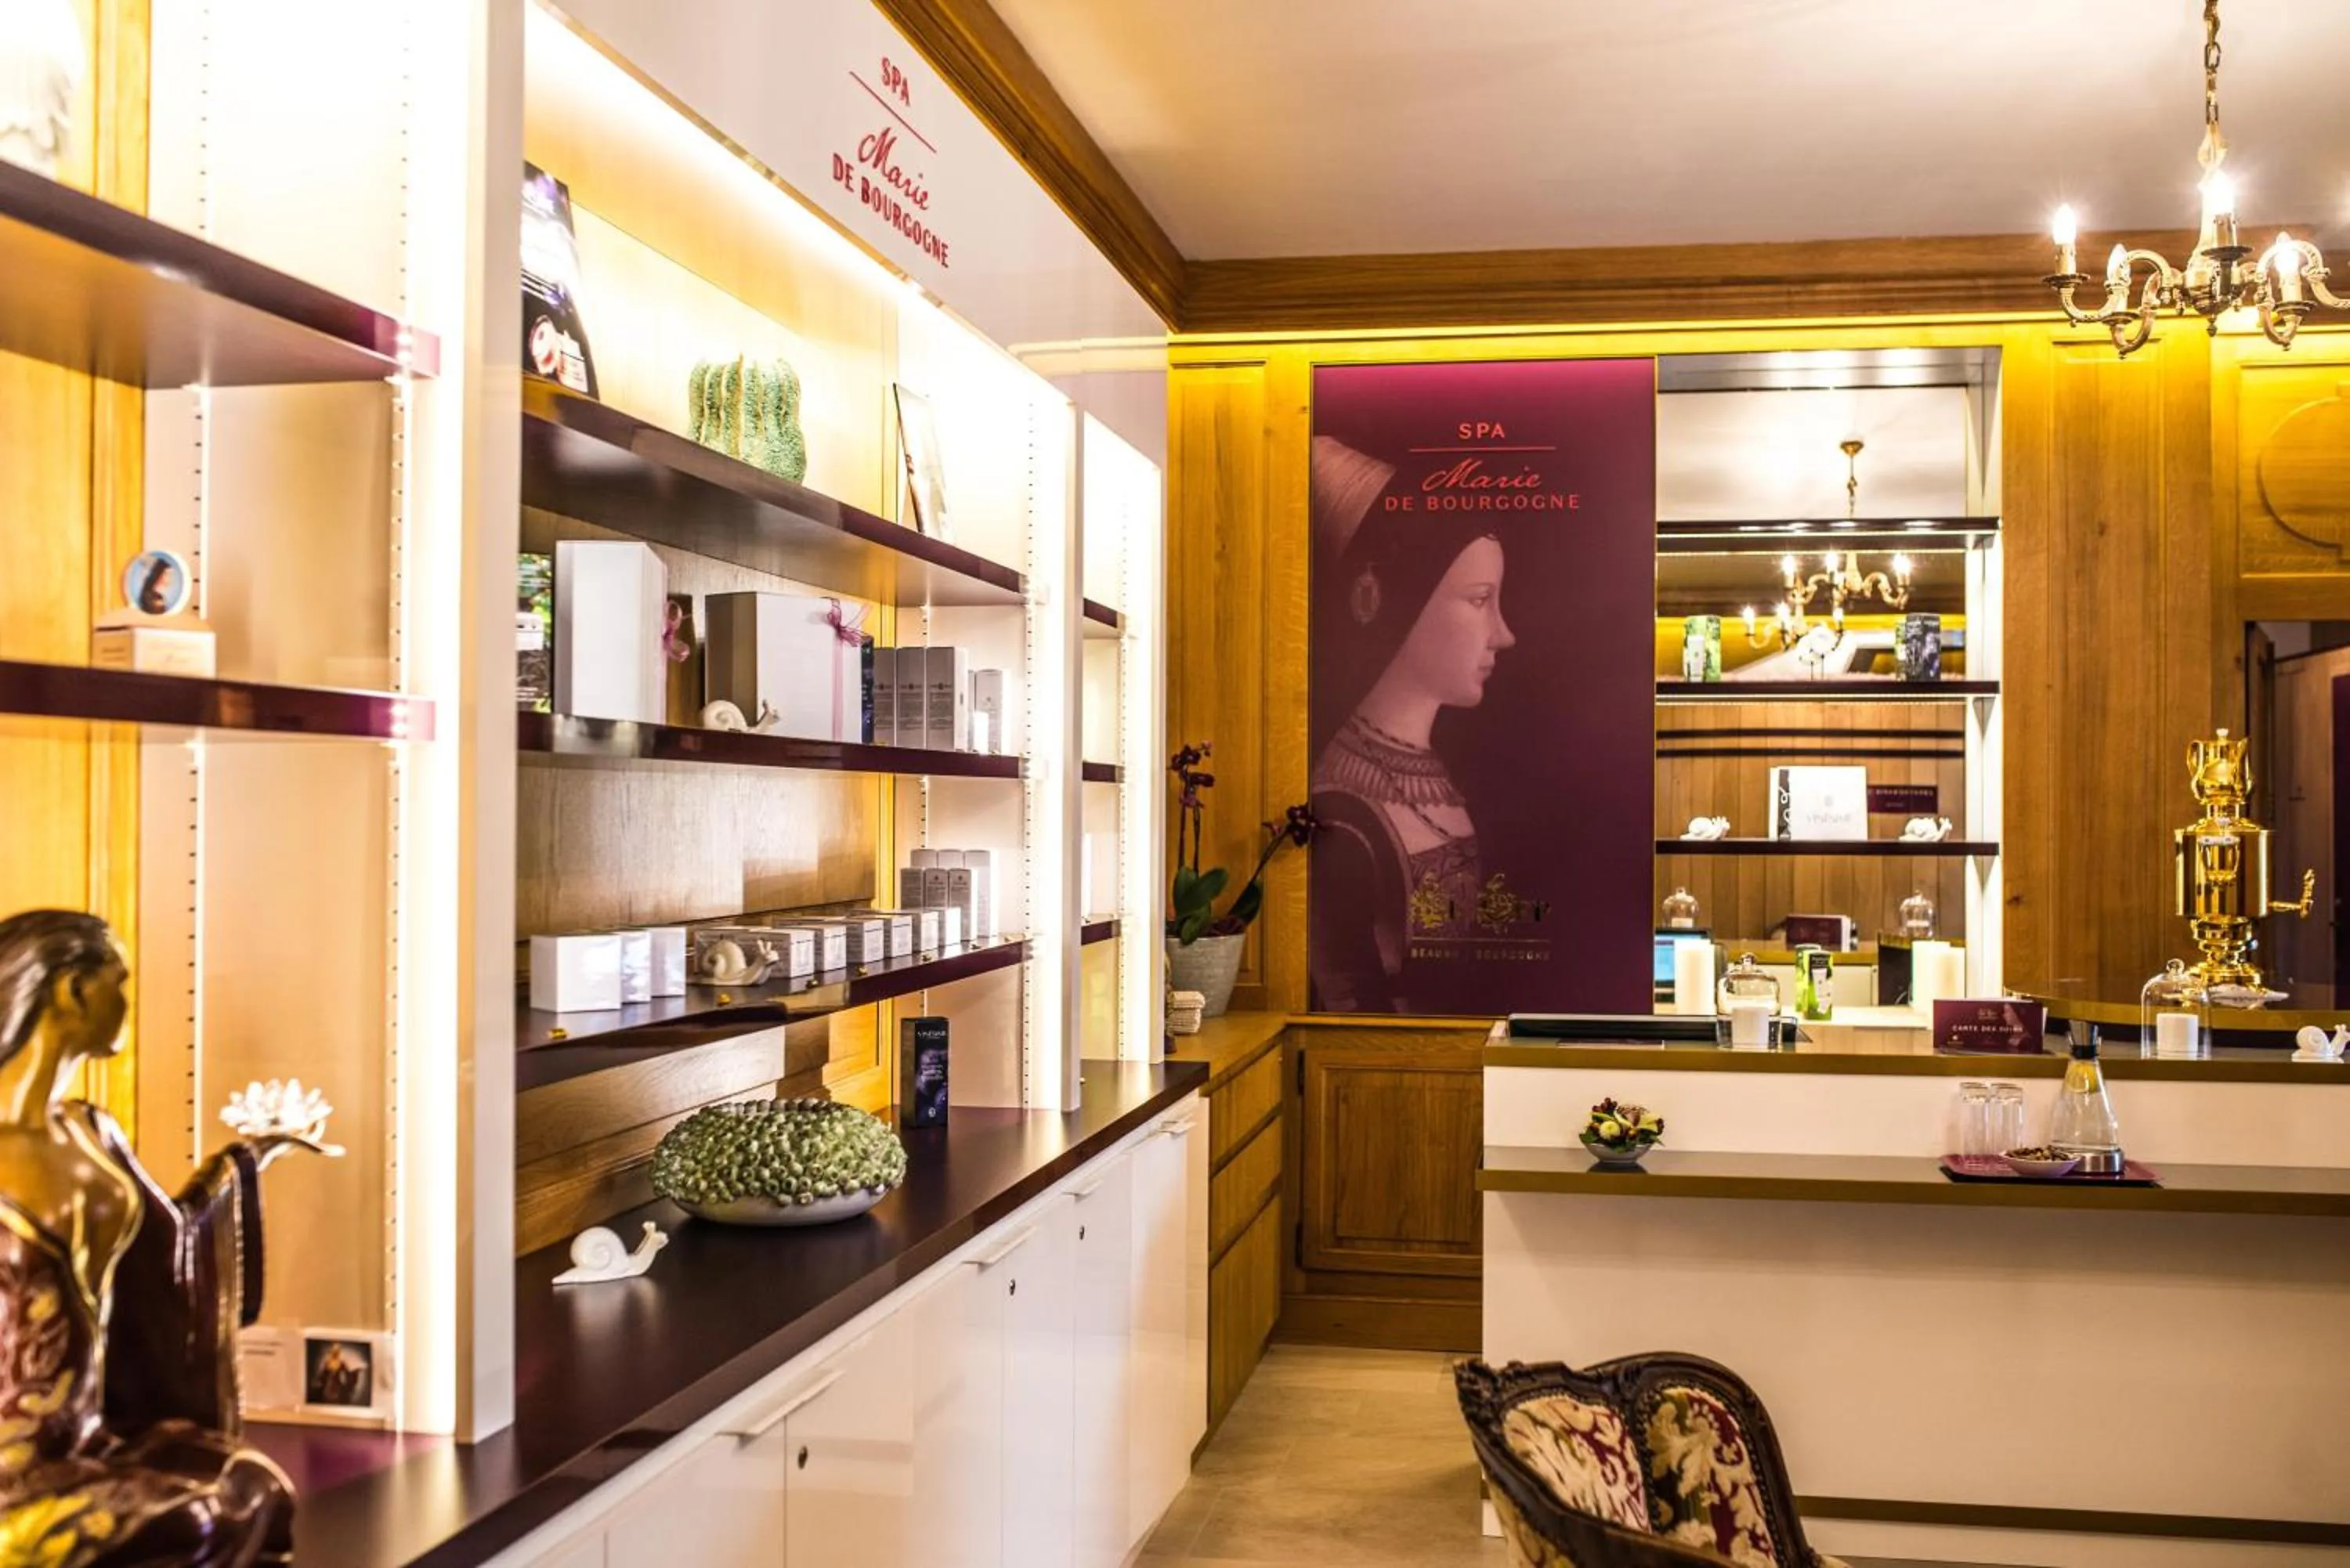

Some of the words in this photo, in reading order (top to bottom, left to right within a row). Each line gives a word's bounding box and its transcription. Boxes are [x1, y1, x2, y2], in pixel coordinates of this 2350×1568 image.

[881, 56, 910, 107] SPA
[858, 127, 930, 211] Marie
[833, 153, 855, 192] DE
[861, 176, 949, 268] BOURGOGNE
[1459, 423, 1505, 439] SPA
[1422, 457, 1542, 491] Marie
[1385, 496, 1413, 511] DE
[1427, 494, 1580, 511] BOURGOGNE
[1952, 1024, 1978, 1033] CARTE
